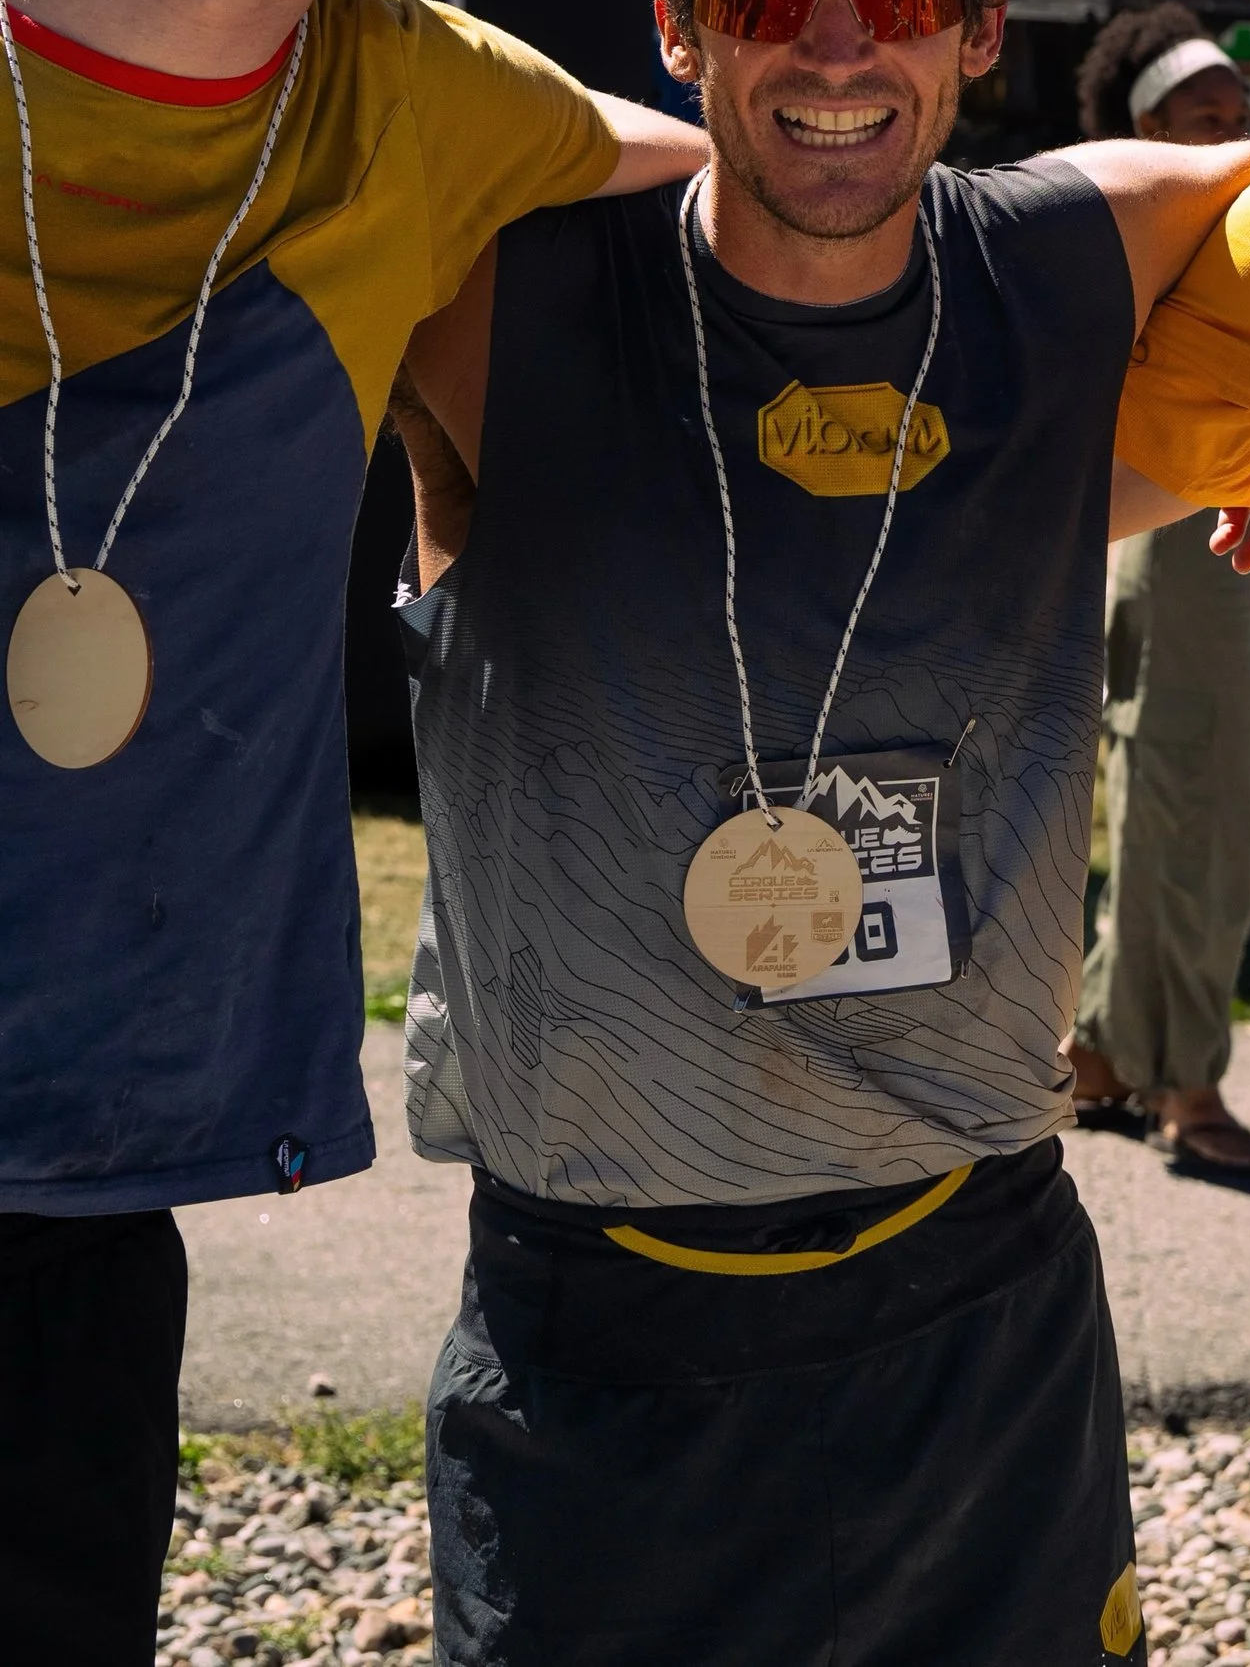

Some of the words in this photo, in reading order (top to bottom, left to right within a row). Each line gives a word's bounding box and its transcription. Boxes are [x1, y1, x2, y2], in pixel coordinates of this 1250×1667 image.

[728, 875, 796, 888] CIRQUE
[728, 887, 818, 902] SERIES
[751, 963, 798, 972] ARAPAHOE
